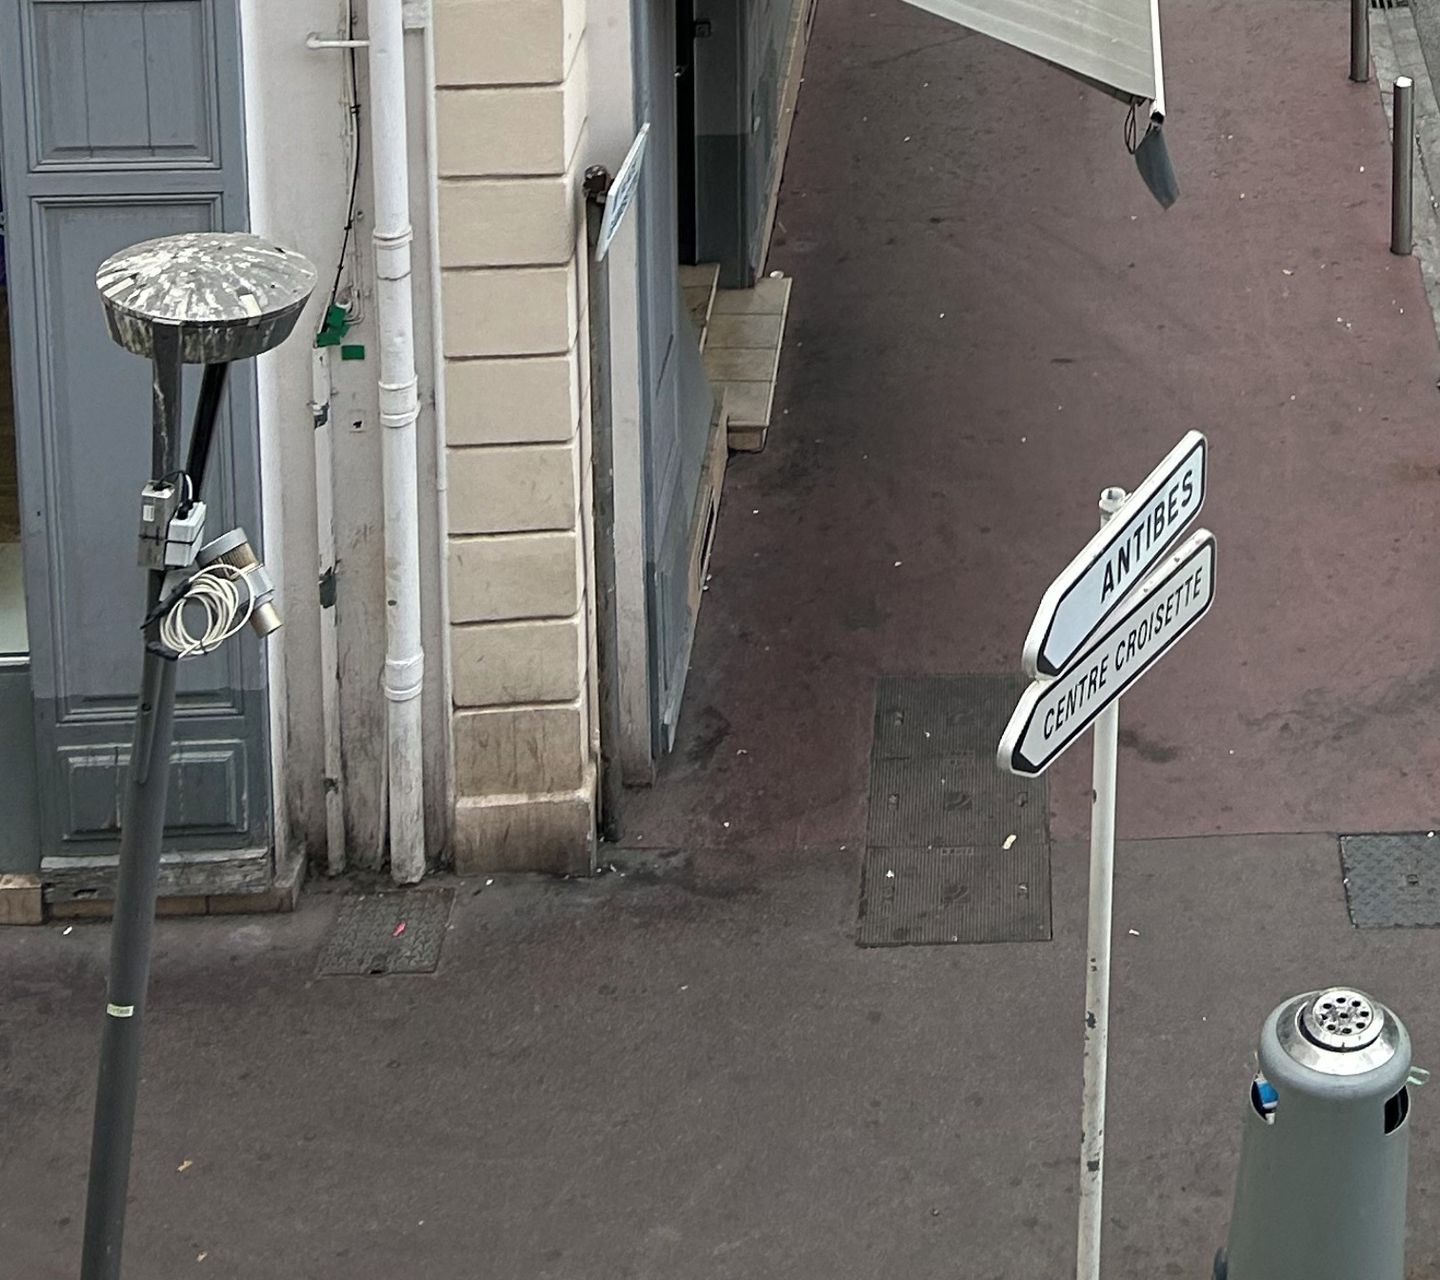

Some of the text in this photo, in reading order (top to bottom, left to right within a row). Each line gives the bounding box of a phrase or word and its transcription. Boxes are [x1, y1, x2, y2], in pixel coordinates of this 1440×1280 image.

[1100, 469, 1194, 604] ANTIBES
[1042, 566, 1203, 741] CENTRE CROISETTE
